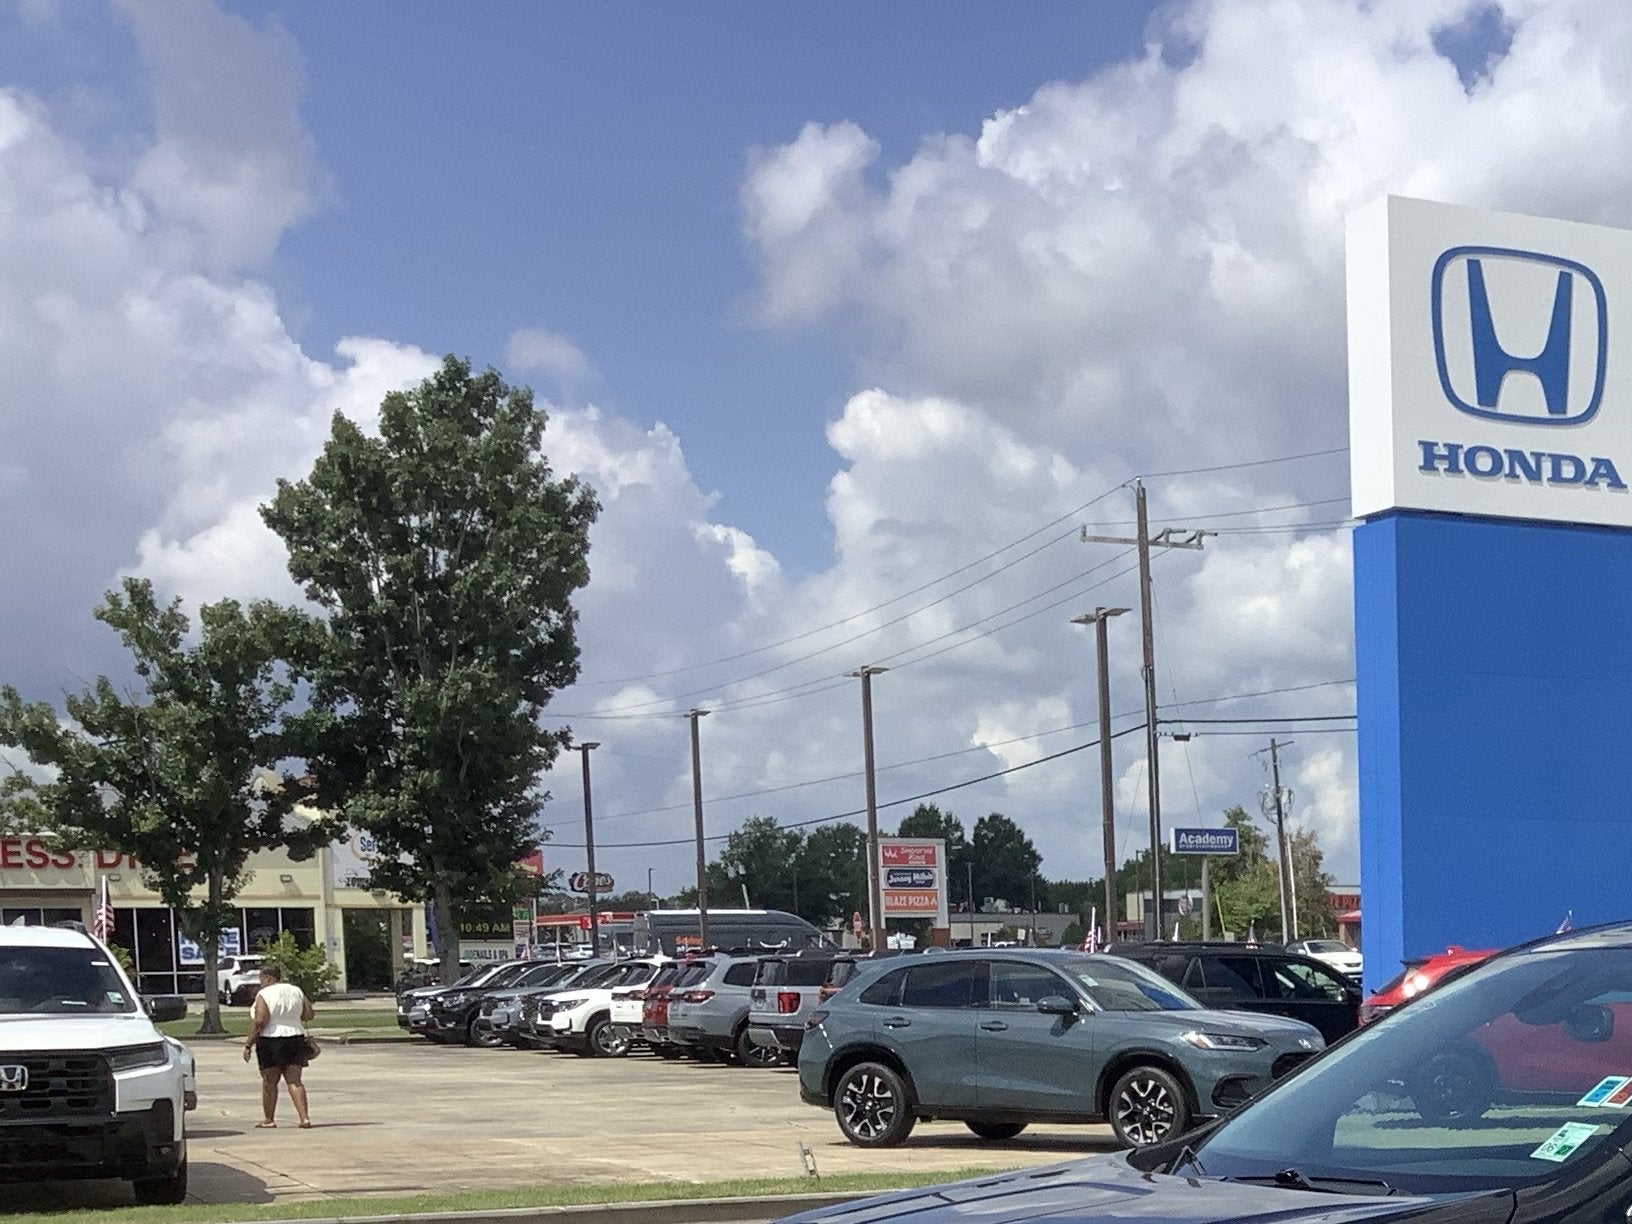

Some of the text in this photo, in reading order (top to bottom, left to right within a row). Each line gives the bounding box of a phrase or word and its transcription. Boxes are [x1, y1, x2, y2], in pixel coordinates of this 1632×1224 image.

[1418, 440, 1628, 489] HONDA
[1179, 832, 1233, 848] Academy
[908, 895, 929, 906] PIZZA
[460, 922, 489, 932] 10:49
[492, 922, 511, 932] AM
